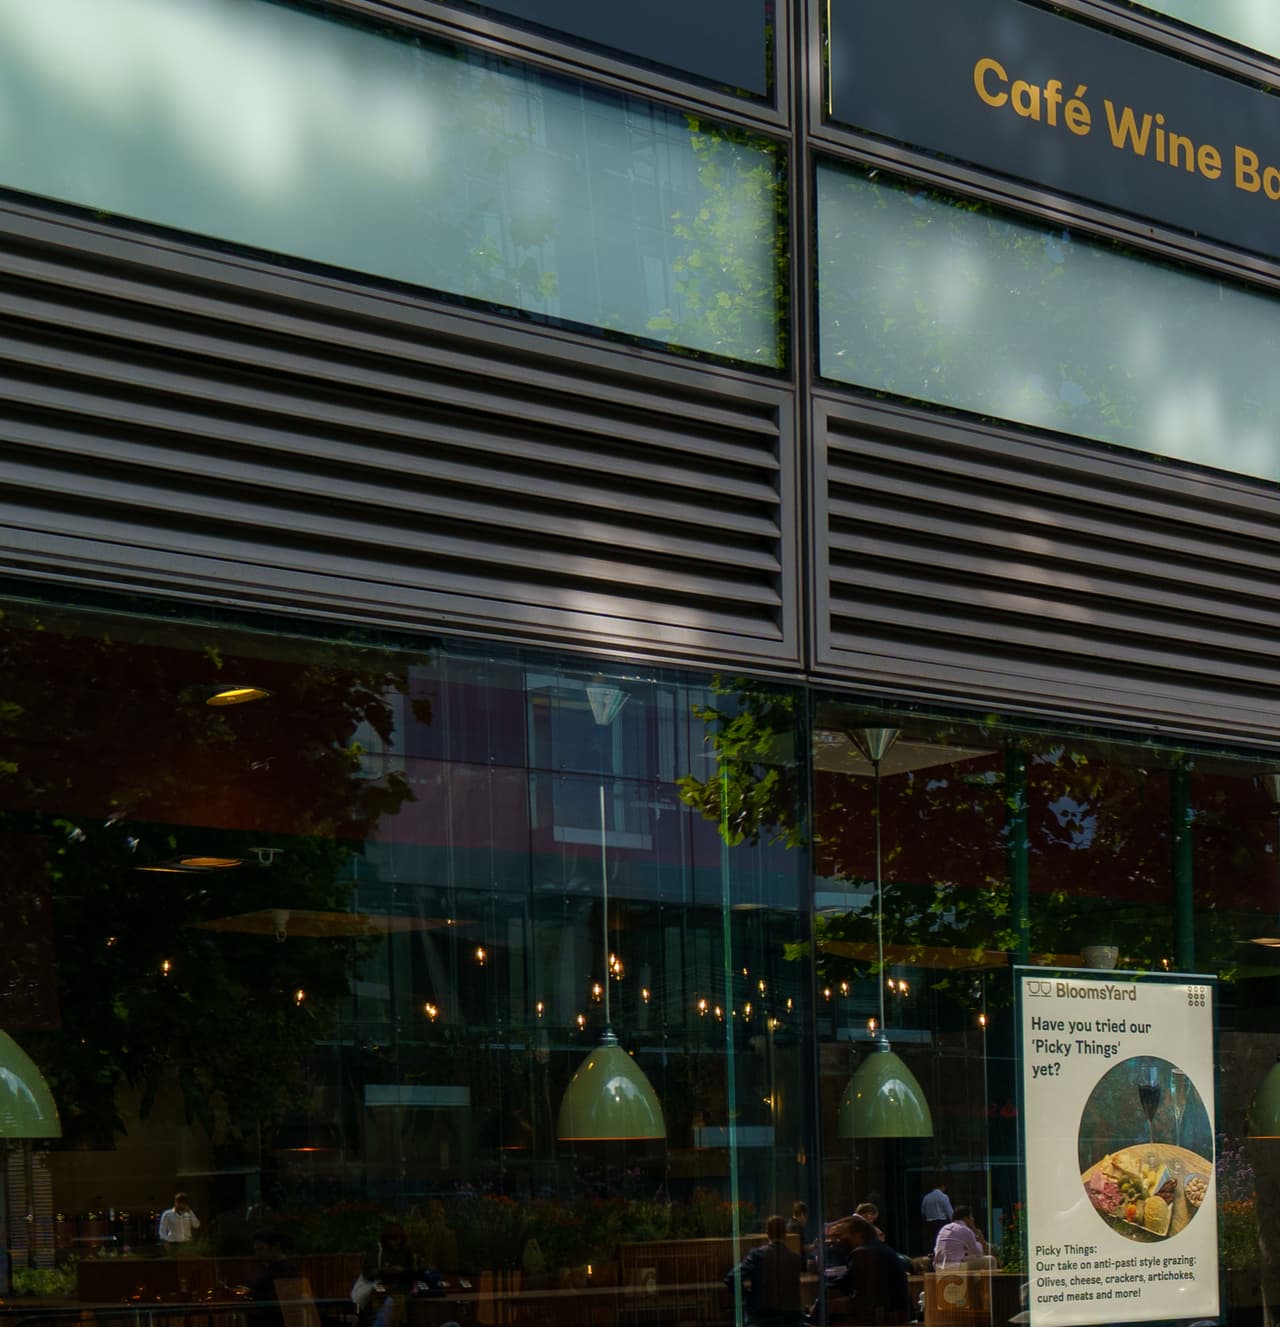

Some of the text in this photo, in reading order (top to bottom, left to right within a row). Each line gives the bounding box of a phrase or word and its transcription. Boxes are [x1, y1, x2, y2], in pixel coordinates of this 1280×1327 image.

[973, 58, 1091, 135] Café
[1104, 99, 1222, 179] Wine
[1056, 983, 1137, 1000] BloomsYard
[1032, 1017, 1151, 1034] Have you tried our
[1032, 1062, 1061, 1078] yet?
[1036, 1245, 1097, 1256] Picky Things:
[1036, 1261, 1055, 1271] Our
[1058, 1260, 1078, 1270] take
[1094, 1257, 1137, 1270] anti-pasti
[1139, 1256, 1160, 1268] style
[1163, 1255, 1197, 1267] grazing:
[1037, 1271, 1195, 1288] Olives, cheese, crackers, artichokes,
[1037, 1288, 1141, 1303] cured meats and more!
